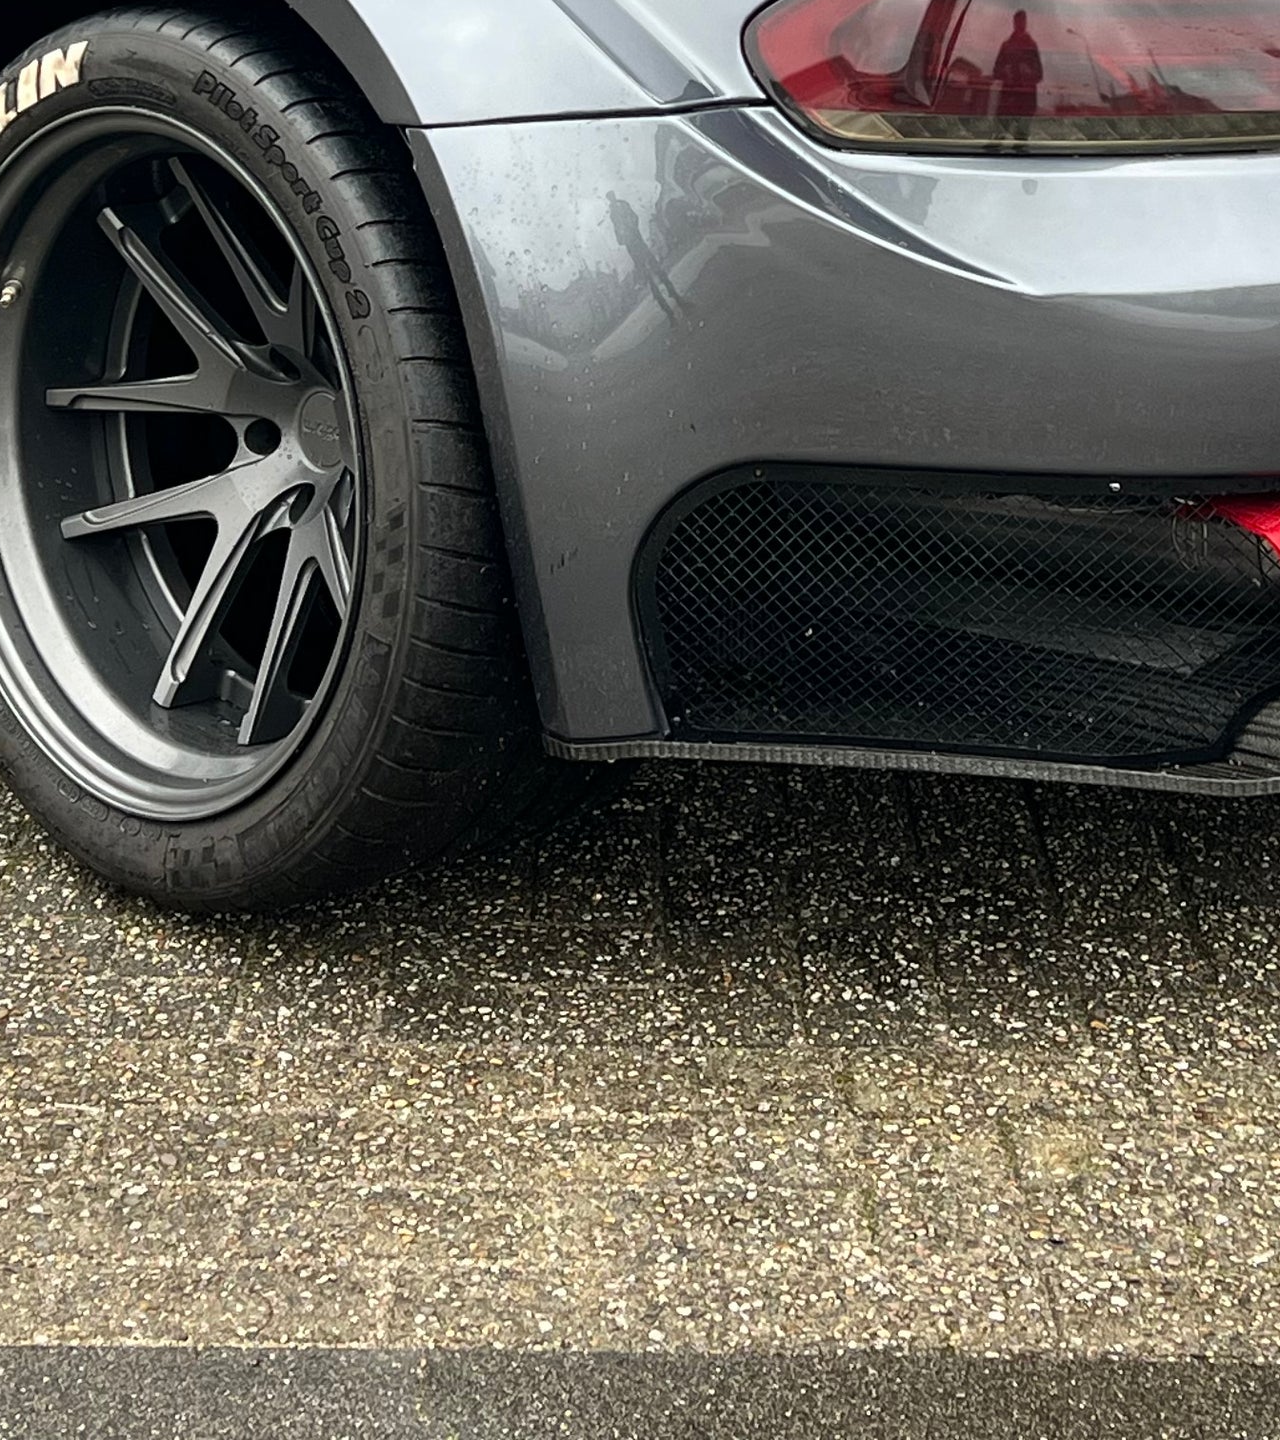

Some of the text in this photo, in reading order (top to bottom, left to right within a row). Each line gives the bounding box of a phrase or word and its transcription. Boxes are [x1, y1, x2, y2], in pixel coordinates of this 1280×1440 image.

[252, 123, 323, 215] Sport
[316, 215, 351, 284] Cup
[344, 288, 370, 321] 2
